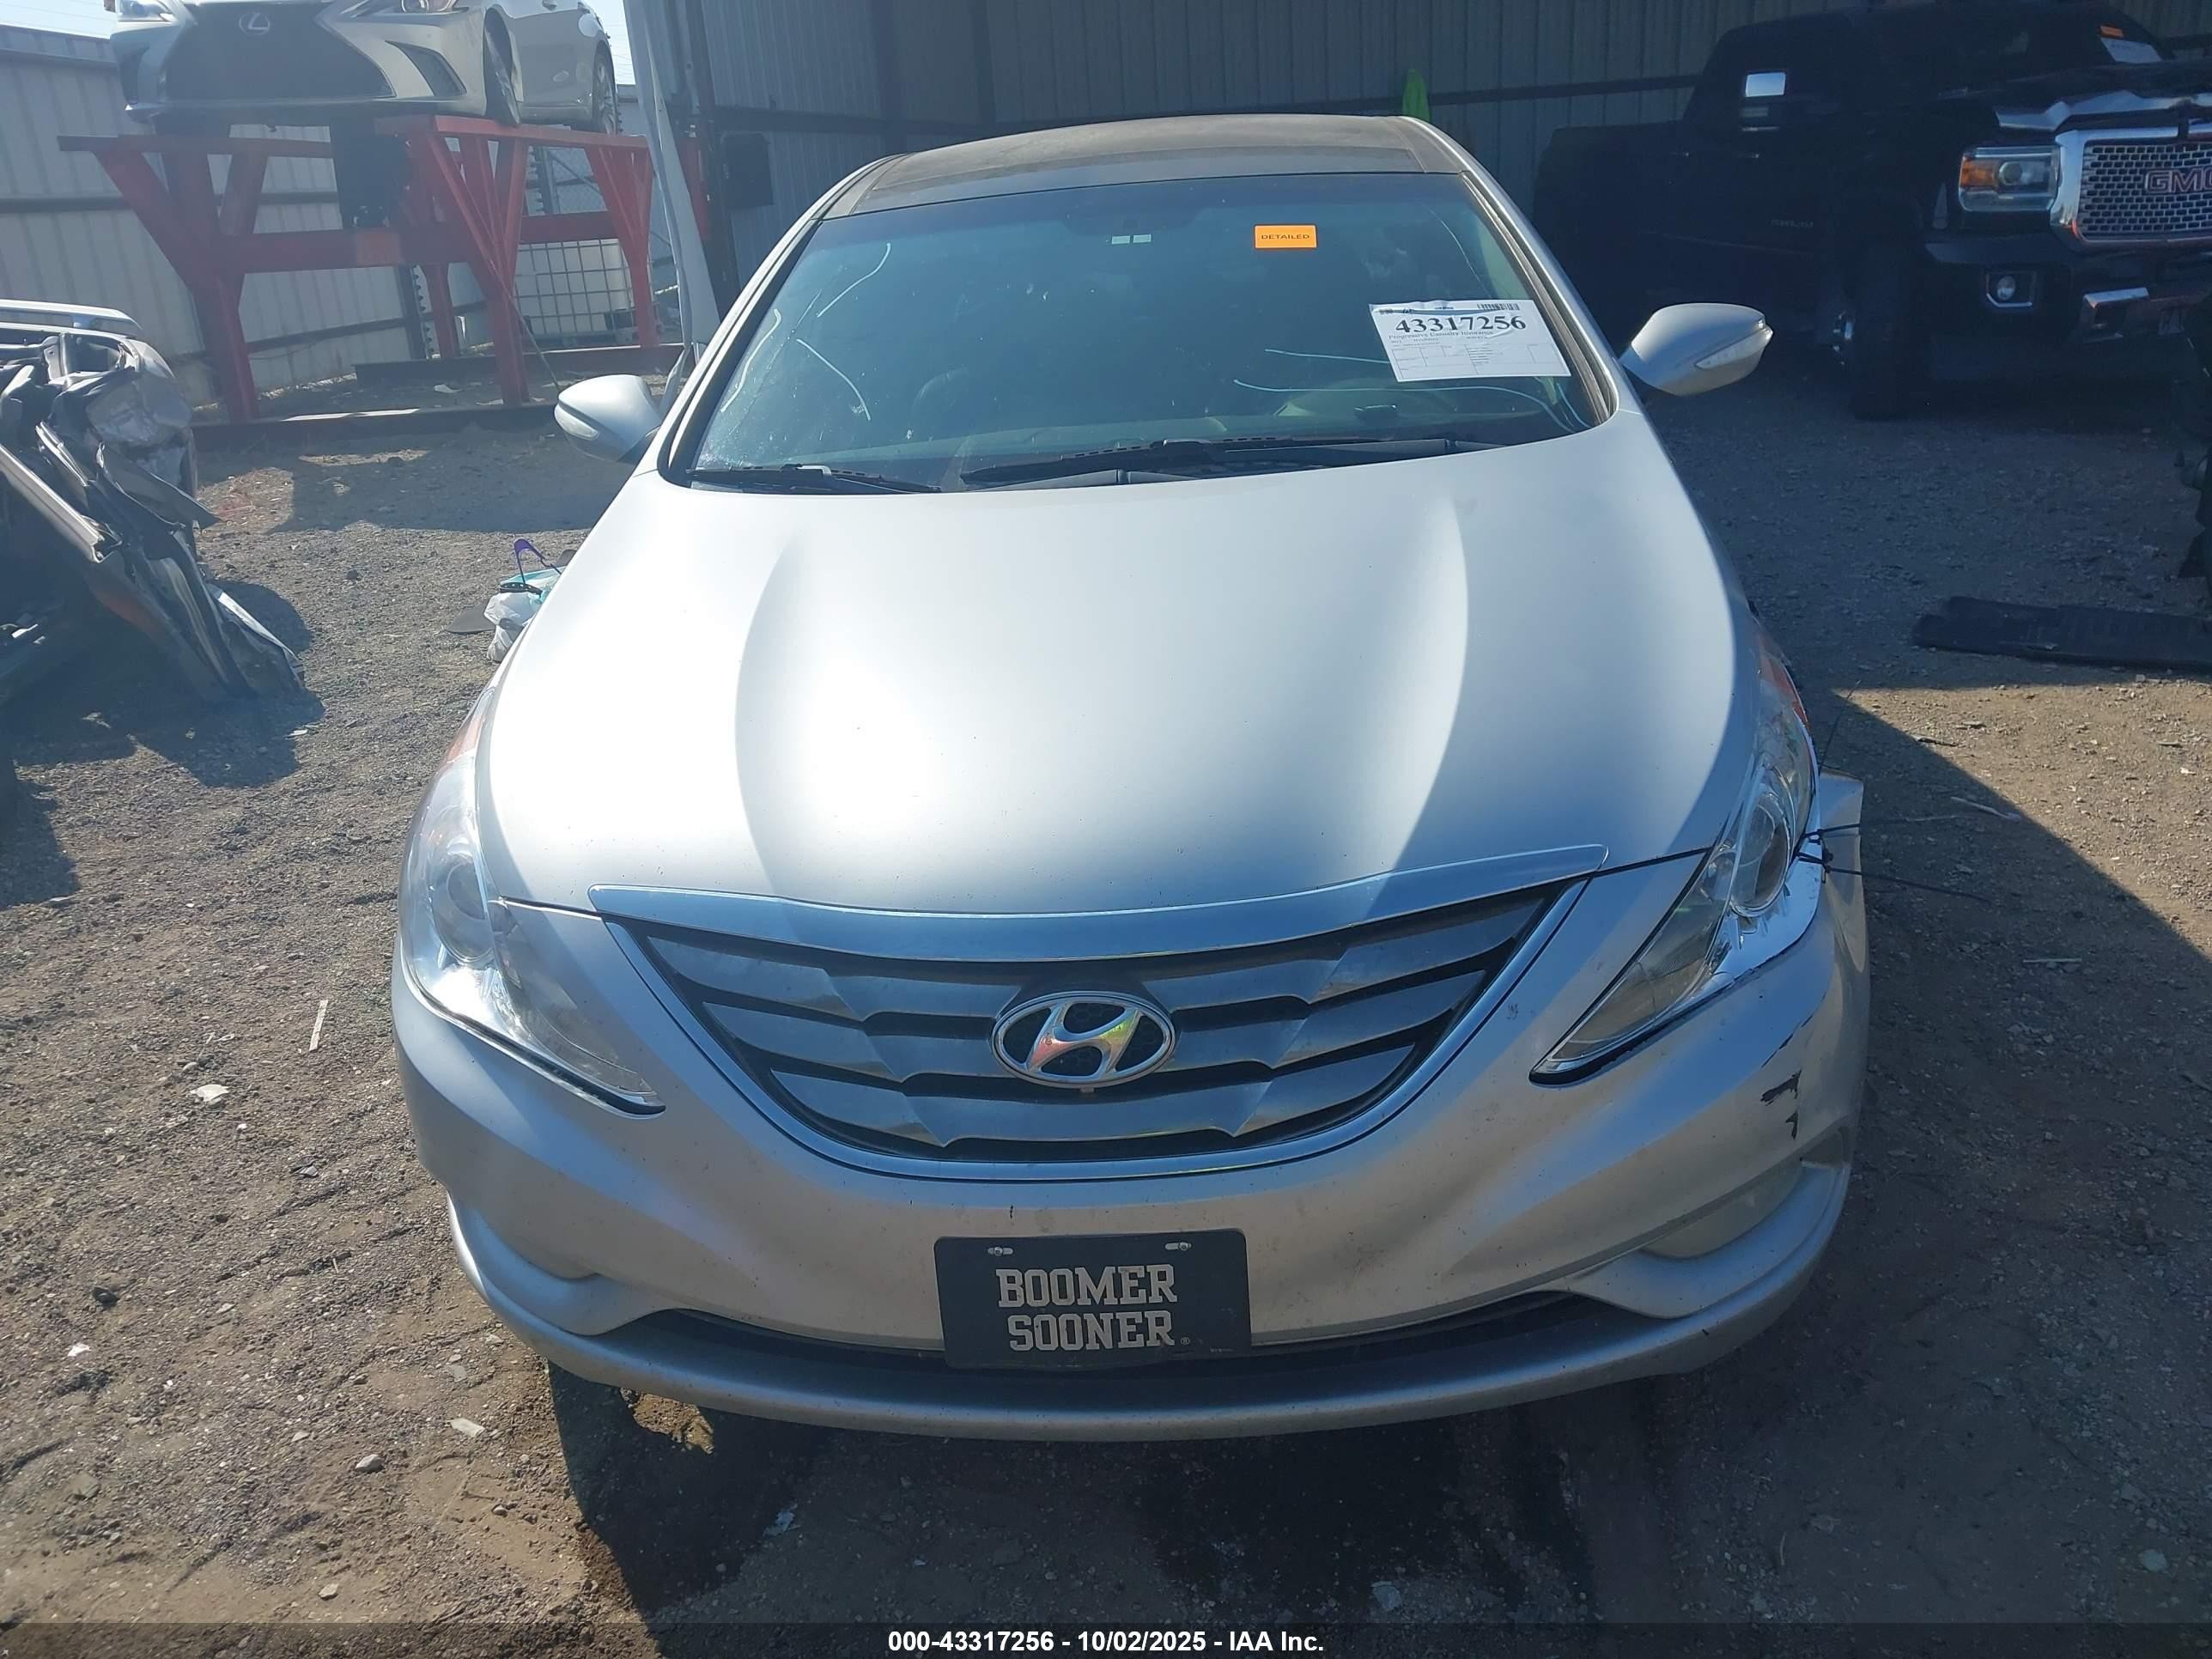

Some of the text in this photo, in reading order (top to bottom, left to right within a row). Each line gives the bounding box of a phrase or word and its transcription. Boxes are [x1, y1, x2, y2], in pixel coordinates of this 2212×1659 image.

[1395, 315, 1526, 333] 43317256
[995, 1264, 1178, 1308] BOOMER
[1007, 1310, 1176, 1352] SOONER
